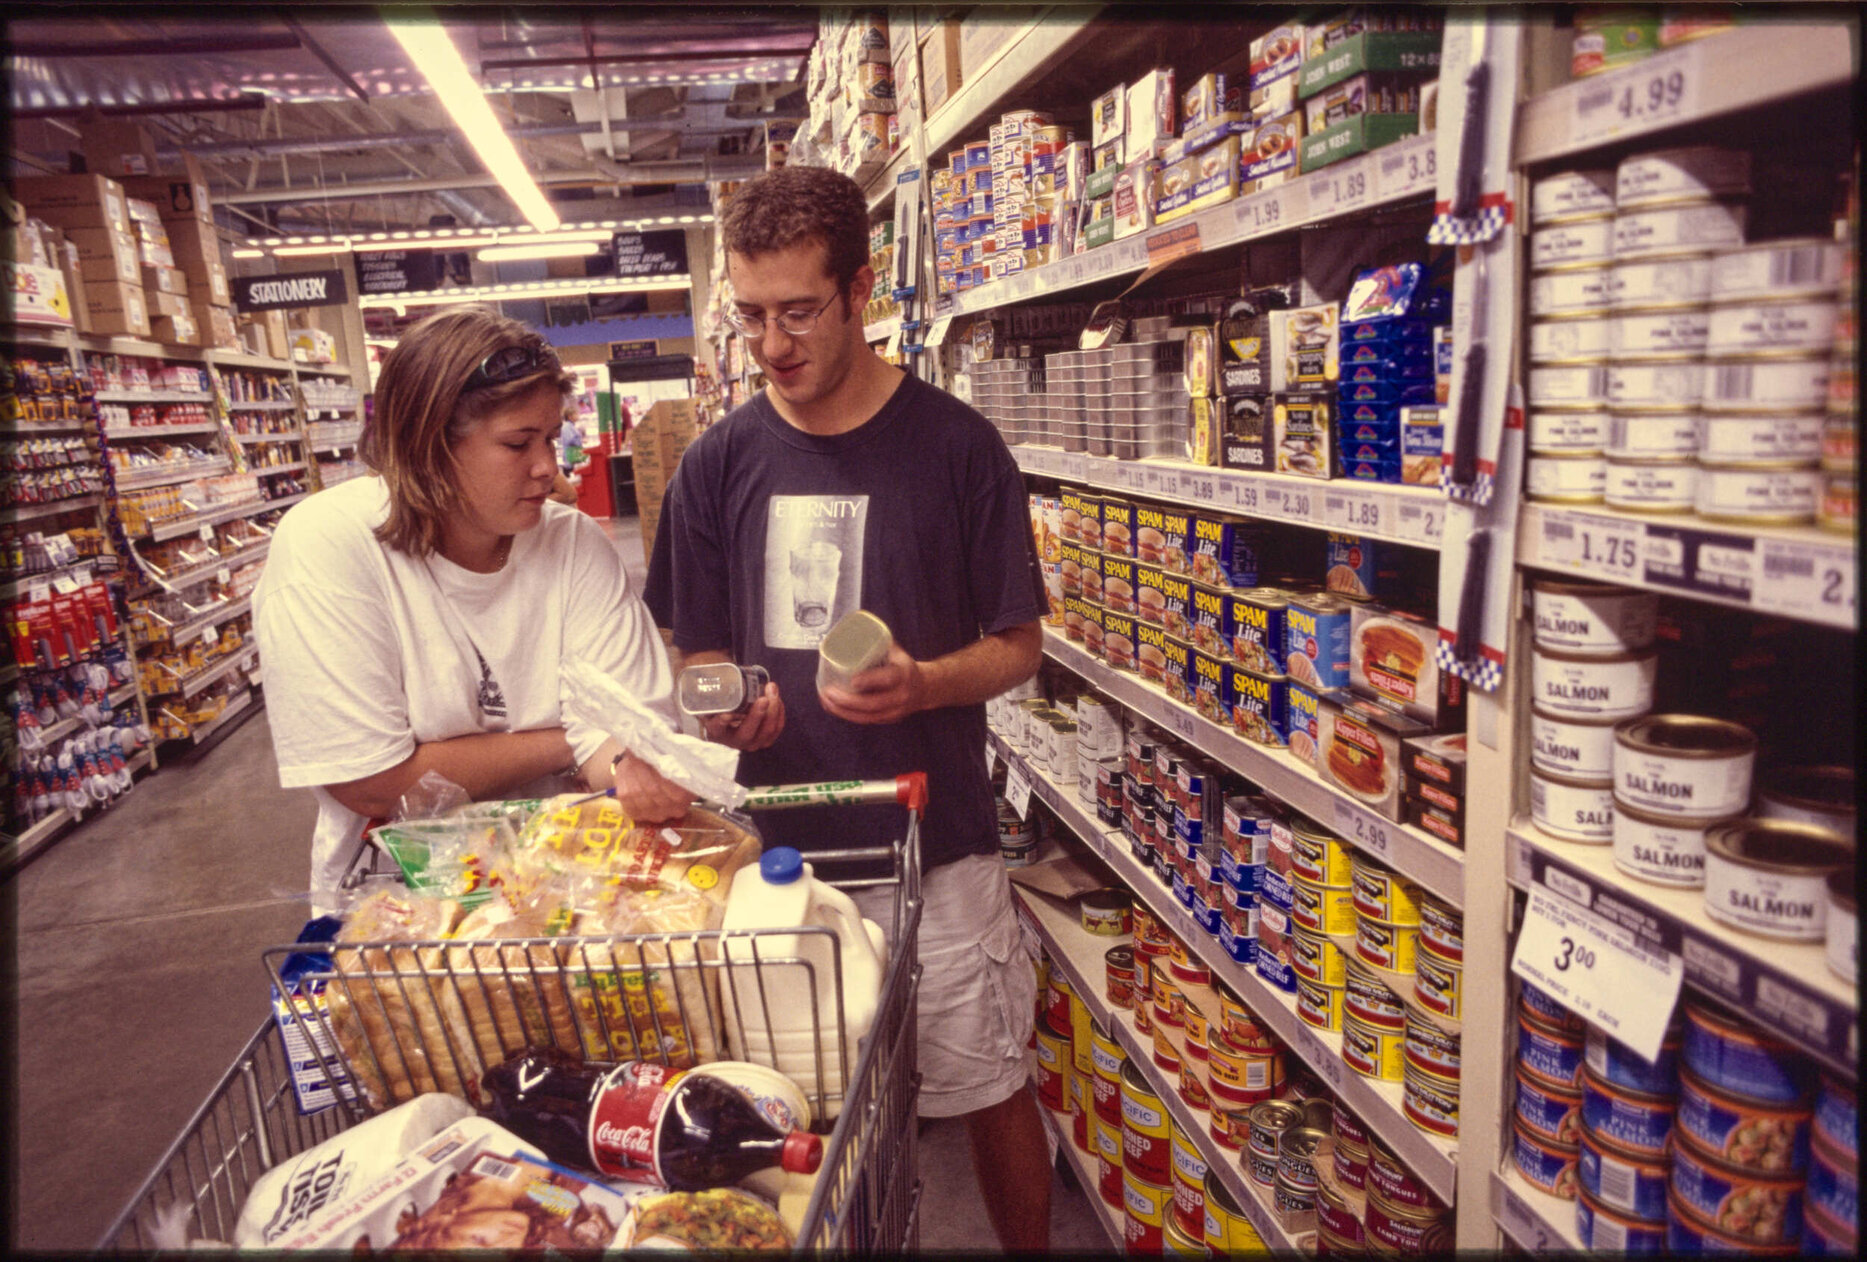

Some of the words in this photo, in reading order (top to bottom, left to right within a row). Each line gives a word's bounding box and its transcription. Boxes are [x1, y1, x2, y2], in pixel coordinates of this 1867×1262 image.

[1305, 66, 1326, 85] JOHN
[1327, 53, 1351, 74] WEST
[1617, 70, 1685, 119] 4.99
[1306, 141, 1327, 160] JOHN
[1328, 130, 1351, 150] WEST
[1334, 172, 1366, 203] 1.89
[1253, 199, 1280, 227] 1.99
[249, 278, 327, 304] STATIONERY
[1225, 368, 1261, 388] SARDINES
[1227, 446, 1264, 465] SARDINES
[1128, 471, 1144, 489] 1.15
[1160, 475, 1177, 495] 1.15
[1192, 479, 1214, 500] 3.89
[1062, 494, 1081, 510] SPAM
[1234, 486, 1258, 508] 1.59
[1282, 493, 1310, 517] 2.30
[775, 500, 862, 519] ETERNITY
[1081, 502, 1099, 519] SPAM
[1105, 505, 1130, 524] SPAM
[1137, 510, 1163, 529] SPAM
[1347, 501, 1379, 527] 1.89
[1165, 514, 1188, 536] SPAM
[1195, 519, 1222, 542] SPAM
[1167, 533, 1184, 550] Lite
[1199, 539, 1217, 557] Lite
[1581, 532, 1637, 570] 1.75
[1062, 546, 1081, 563] SPAM
[1081, 553, 1100, 571] SPAM
[1104, 560, 1131, 580] SPAM
[1138, 569, 1164, 590] SPAM
[1164, 578, 1188, 601] SPAM
[1065, 597, 1084, 614] SPAM
[1167, 597, 1184, 615] Lite
[1195, 591, 1221, 616] SPAM
[1083, 604, 1102, 624] SPAM
[1199, 610, 1217, 630] Lite
[1233, 602, 1269, 629] SPAM
[1287, 609, 1317, 637] SPAM
[1105, 616, 1132, 637] SPAM
[1238, 624, 1262, 644] Lite
[1138, 626, 1165, 648] SPAM
[1293, 632, 1307, 651] Lite
[1165, 641, 1187, 667] SPAM
[1167, 660, 1184, 678] Lite
[1196, 655, 1222, 682] SPAM
[1199, 676, 1217, 695] Lite
[1233, 673, 1270, 701] SPAM
[1546, 682, 1611, 701] SALMON
[1239, 695, 1264, 715] Lite
[1289, 687, 1319, 717] SPAM
[1294, 710, 1309, 729] Lite
[1625, 772, 1693, 800] SALMON
[1355, 817, 1387, 850] 2.99
[1632, 844, 1705, 871] SALMON
[1728, 889, 1814, 919] SALMON
[1530, 1048, 1560, 1067] PINK
[1600, 1119, 1665, 1147] SALMON
[1611, 1117, 1649, 1136] PINK
[1382, 1180, 1418, 1200] TONGUES
[1376, 1226, 1398, 1242] LAMB
